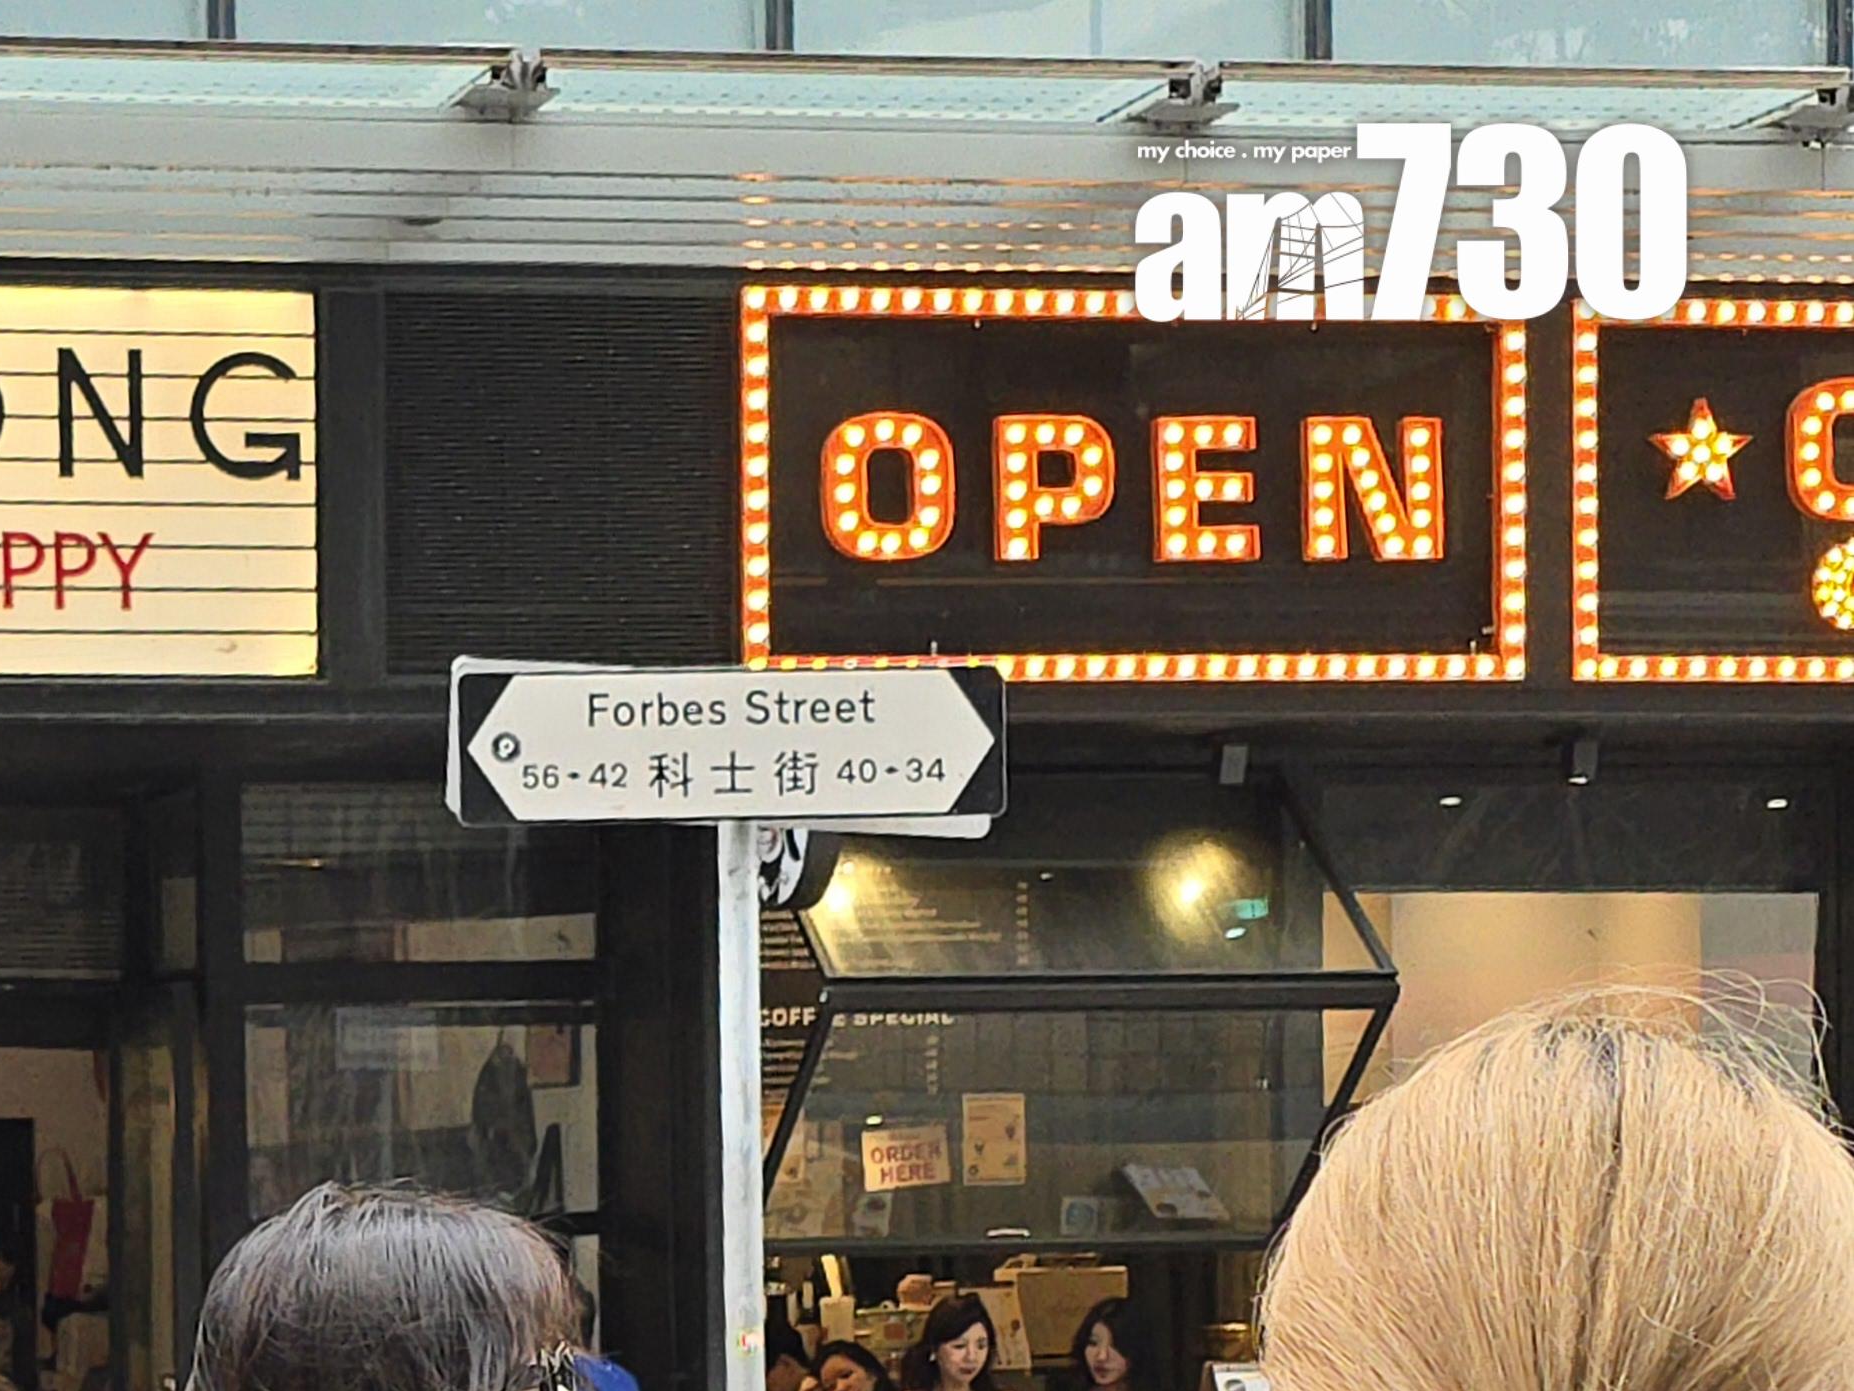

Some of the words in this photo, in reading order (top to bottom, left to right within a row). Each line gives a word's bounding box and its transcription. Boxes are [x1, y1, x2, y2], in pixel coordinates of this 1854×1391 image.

[819, 411, 1444, 564] OPEN
[588, 692, 726, 727] Forbes
[746, 690, 875, 725] Street
[648, 751, 818, 798] 科士街
[759, 1006, 845, 1028] COFFE
[870, 1141, 942, 1164] ORDER
[880, 1162, 936, 1184] HERE
